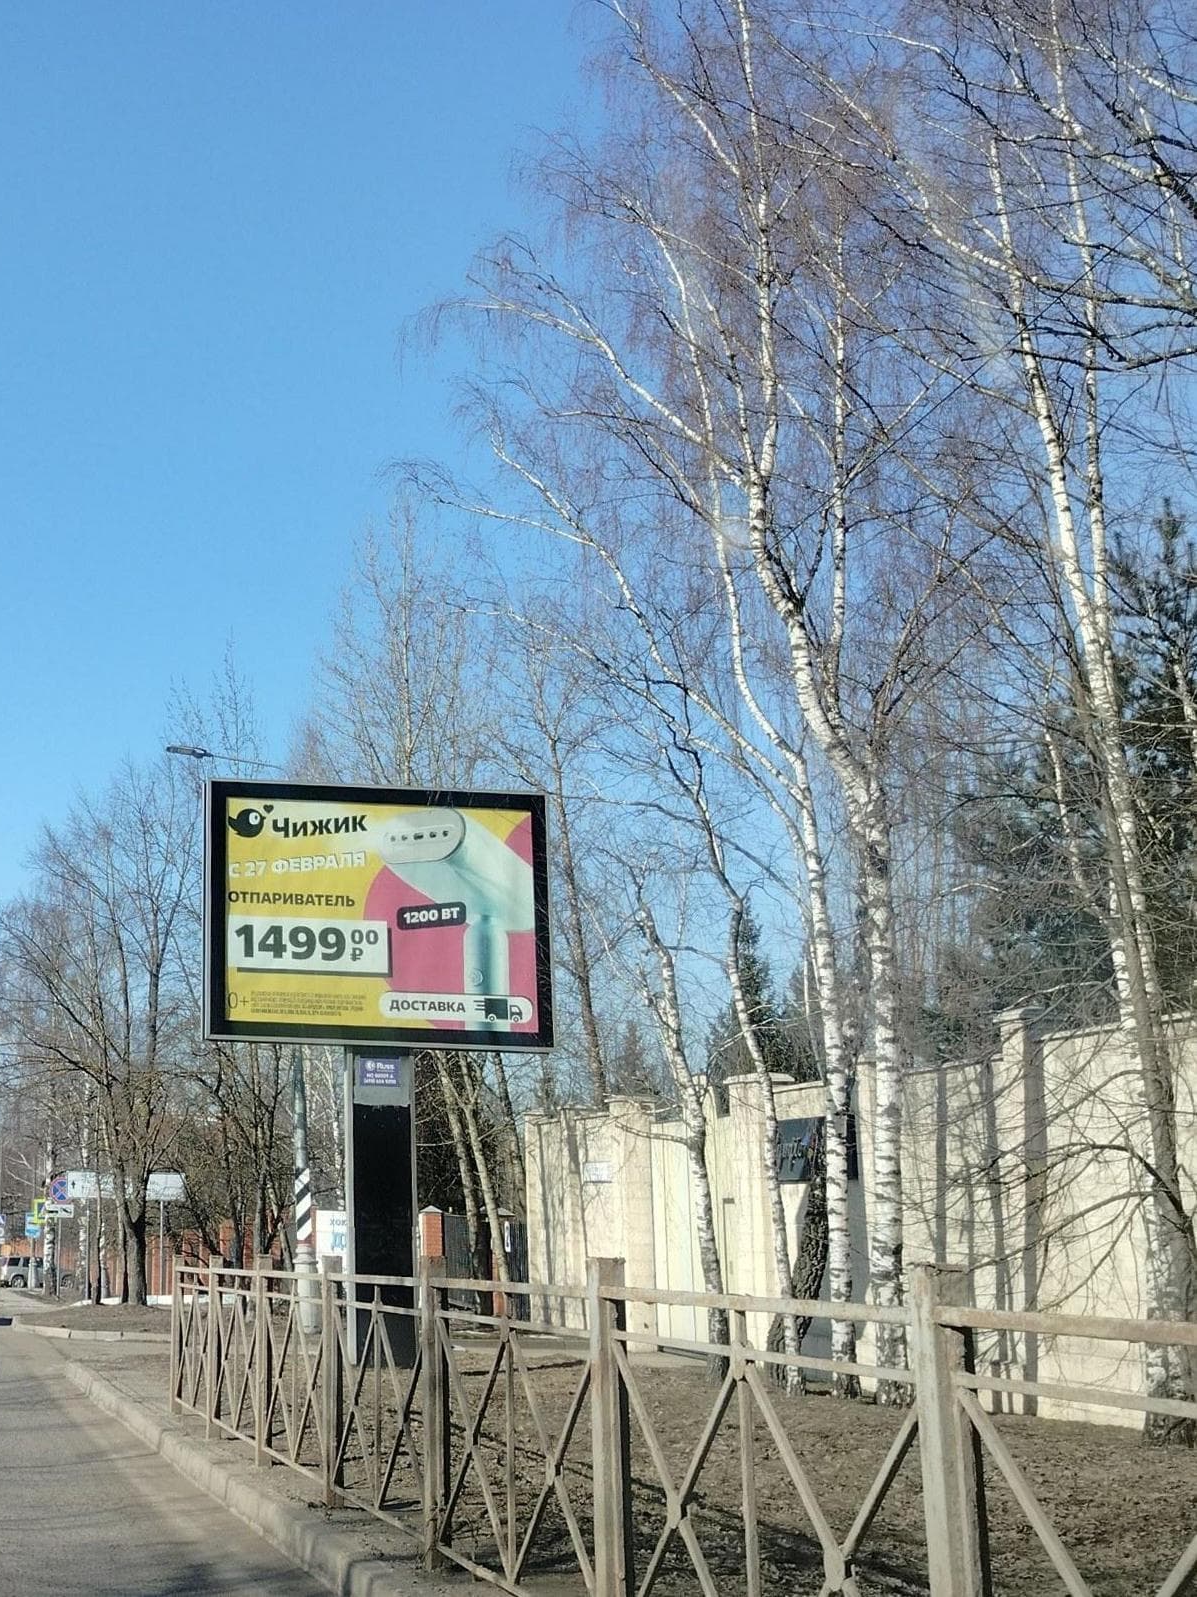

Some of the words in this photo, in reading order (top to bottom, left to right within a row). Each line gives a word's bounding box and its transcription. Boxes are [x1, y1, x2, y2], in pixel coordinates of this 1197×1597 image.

[272, 815, 368, 838] Чижик
[245, 860, 267, 877] 27
[271, 850, 367, 874] ФЕВРАЛЯ
[228, 891, 356, 907] ОТПАРИВАТЕЛЬ
[403, 909, 439, 924] 1200
[442, 907, 460, 920] ВТ
[234, 924, 347, 962] 1499
[350, 929, 379, 945] 00
[389, 1000, 466, 1013] ДОСТАВКА
